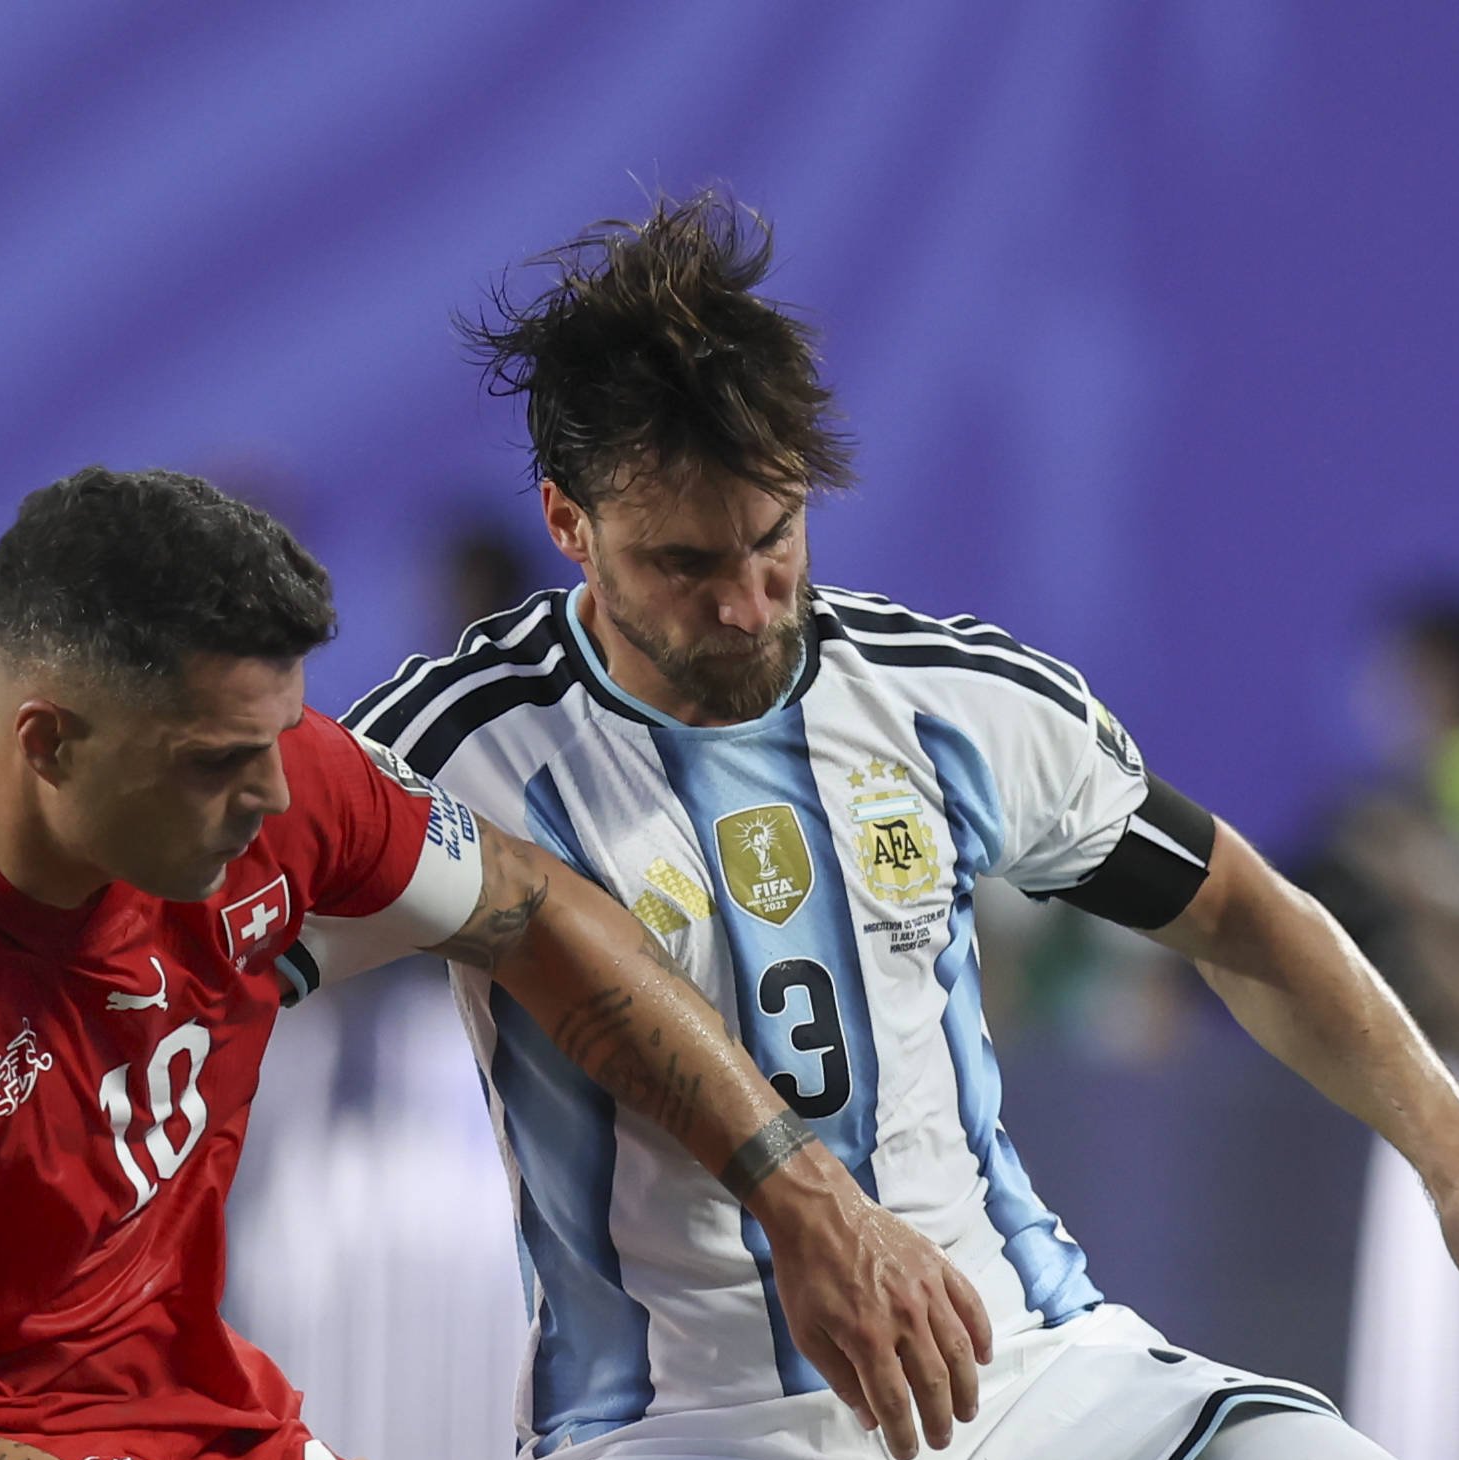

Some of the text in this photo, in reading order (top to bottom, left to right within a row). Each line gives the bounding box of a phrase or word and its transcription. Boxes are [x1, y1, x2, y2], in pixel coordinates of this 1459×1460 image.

[873, 819, 923, 871] AFA
[752, 878, 794, 899] FIFA
[764, 900, 788, 913] 2022
[757, 957, 853, 1121] 3
[99, 1017, 211, 1225] 10
